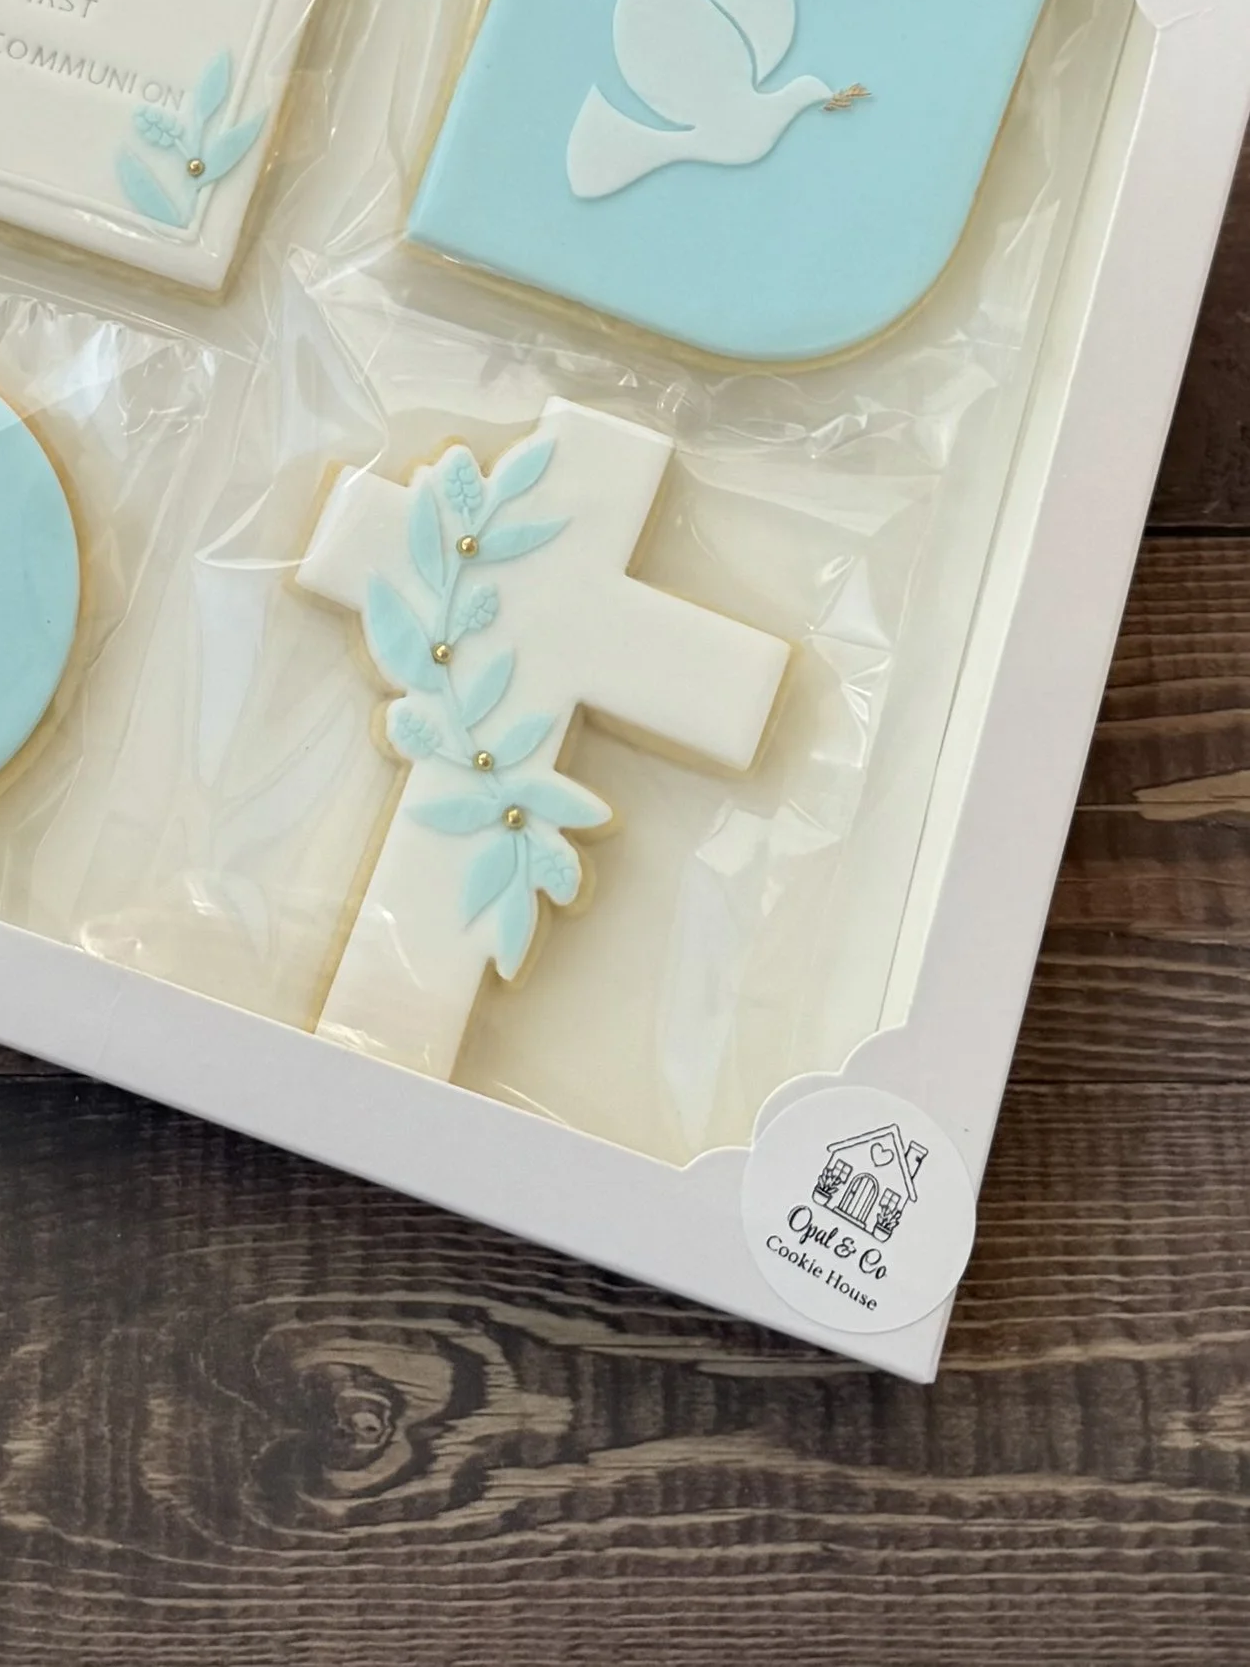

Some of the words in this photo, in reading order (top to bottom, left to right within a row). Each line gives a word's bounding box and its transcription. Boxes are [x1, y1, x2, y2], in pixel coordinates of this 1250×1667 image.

[766, 1235, 823, 1278] Cookie
[825, 1270, 877, 1311] House
[788, 1205, 838, 1248] Opal
[833, 1237, 856, 1258] &
[859, 1248, 887, 1279] Co
